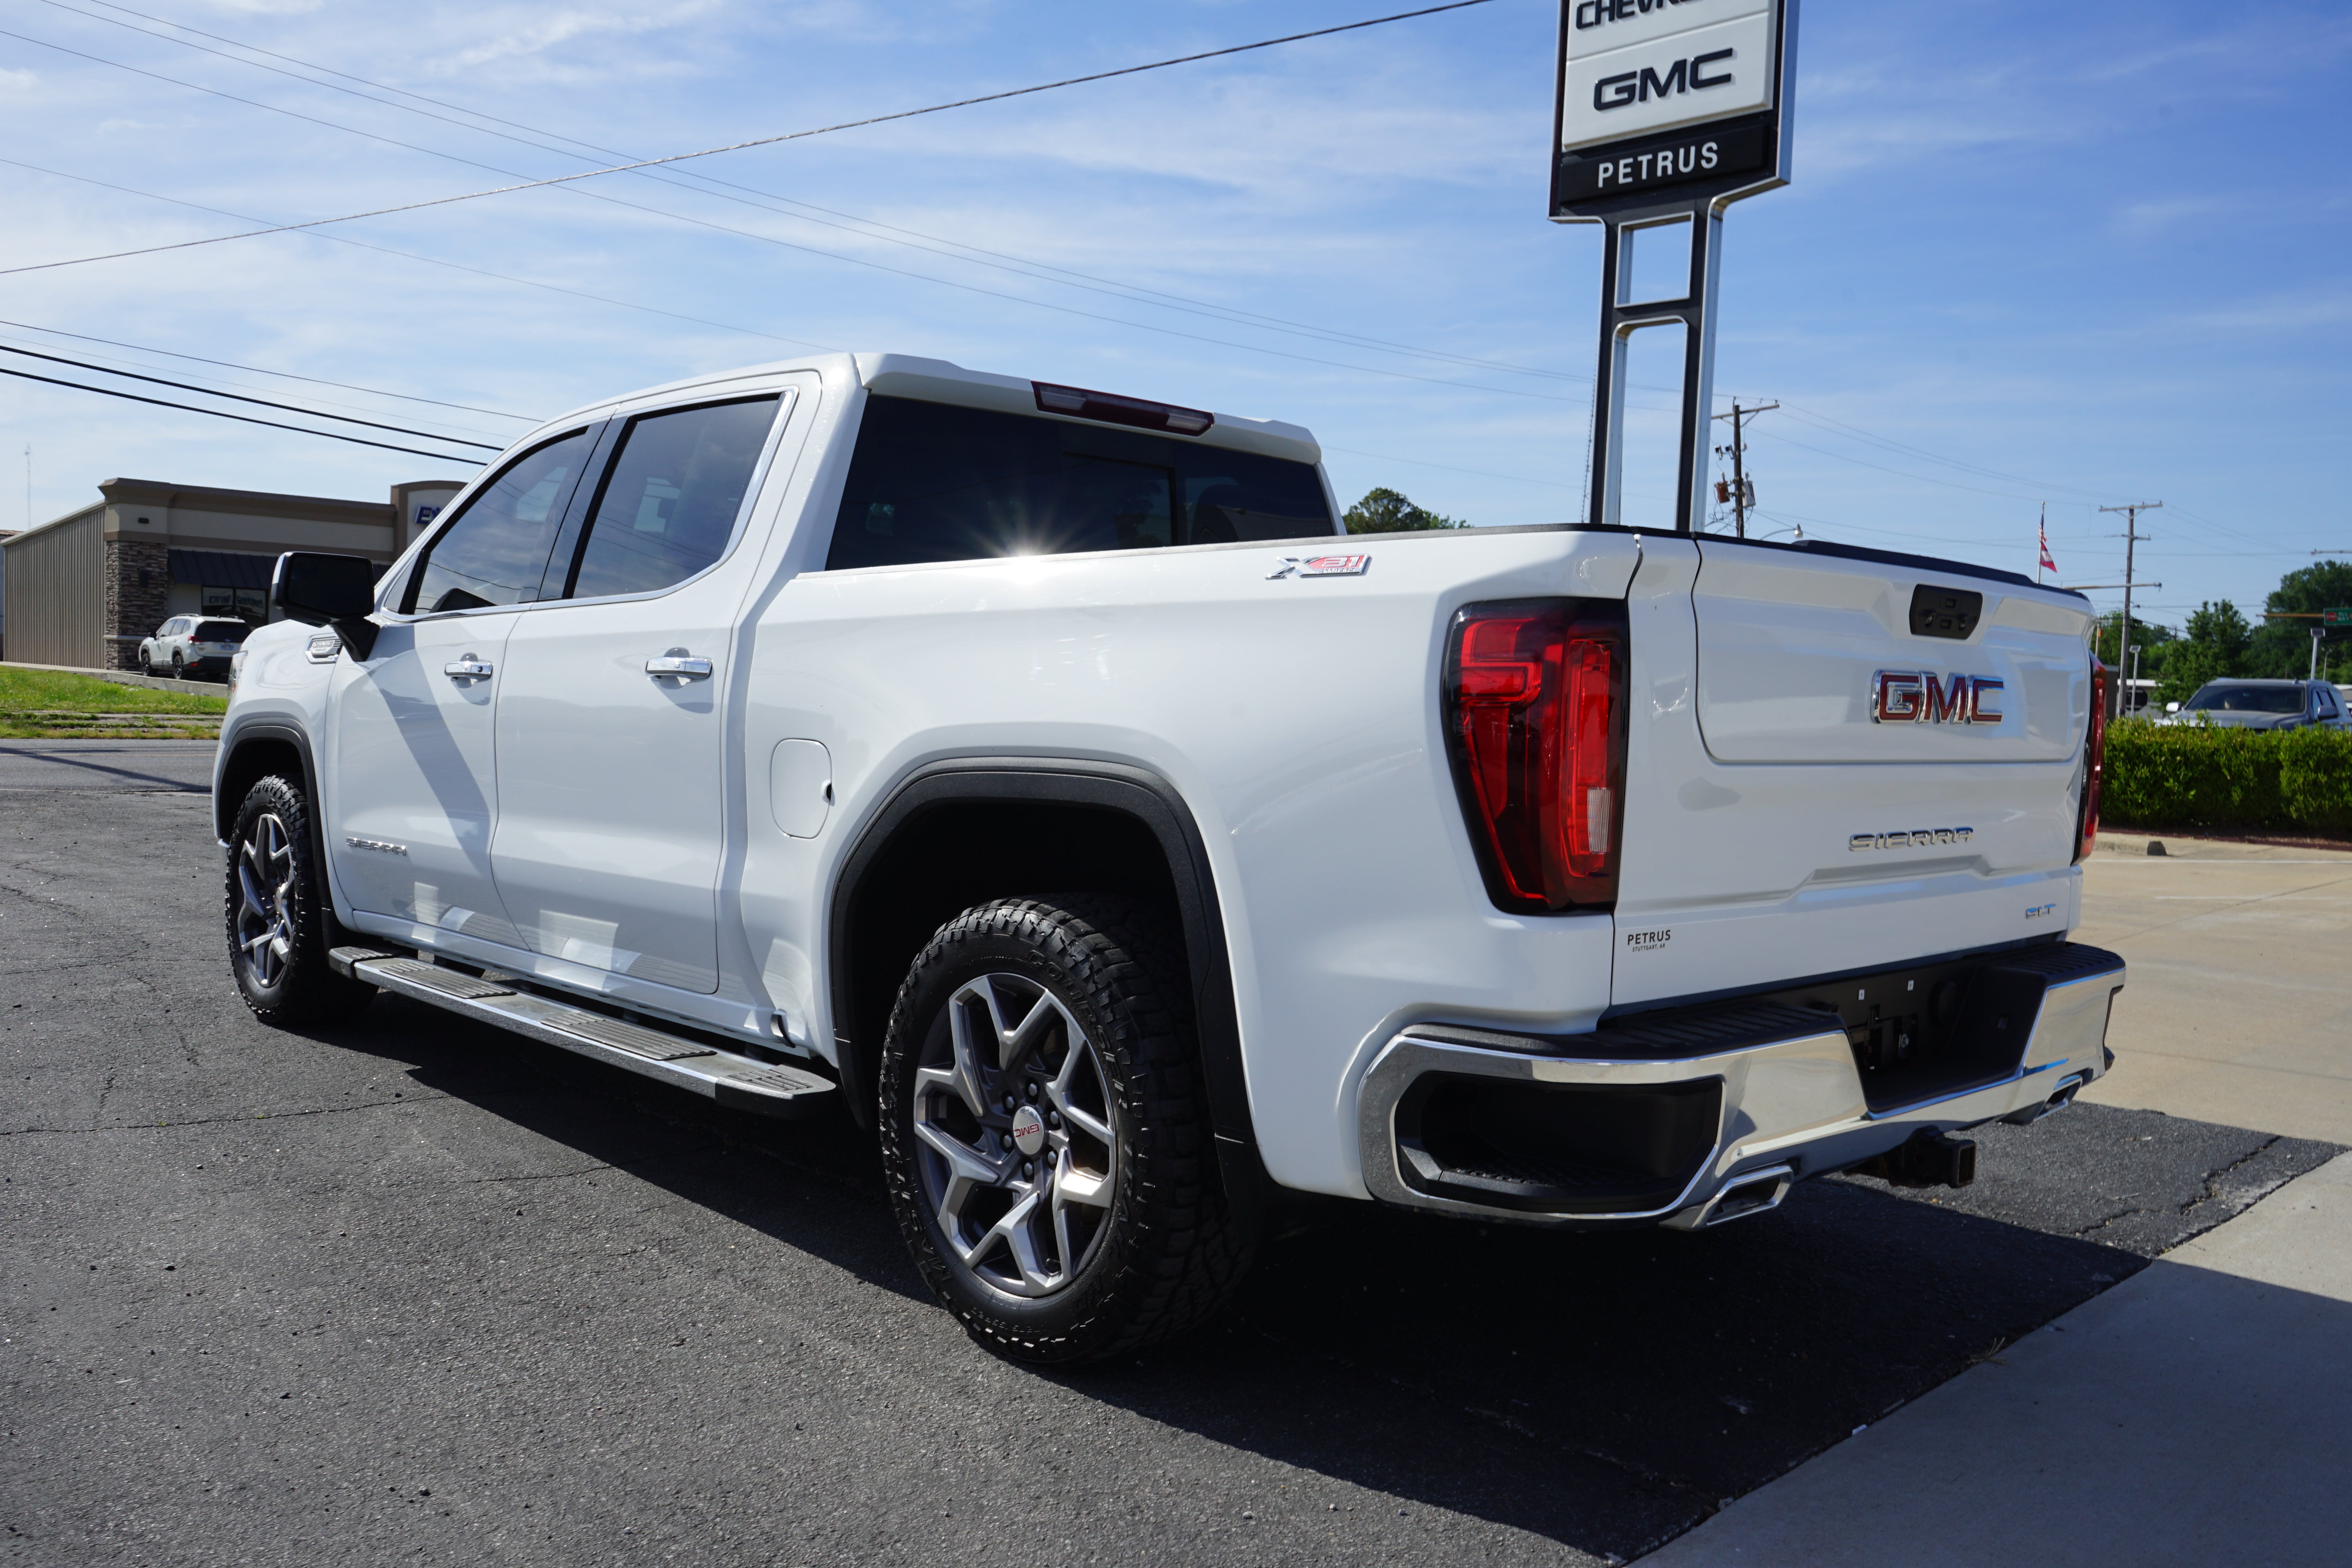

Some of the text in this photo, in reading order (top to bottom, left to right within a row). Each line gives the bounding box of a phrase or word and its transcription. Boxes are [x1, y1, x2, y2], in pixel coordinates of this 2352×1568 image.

[1593, 48, 1733, 111] GMC
[1598, 142, 1718, 188] PETRUS
[1871, 670, 2005, 724] GMC
[346, 837, 407, 856] SIERRA
[1849, 827, 1973, 851] SIERRA
[2025, 904, 2056, 919] SLT
[1628, 929, 1671, 946] PETRUS
[1014, 1123, 1040, 1138] GMC
